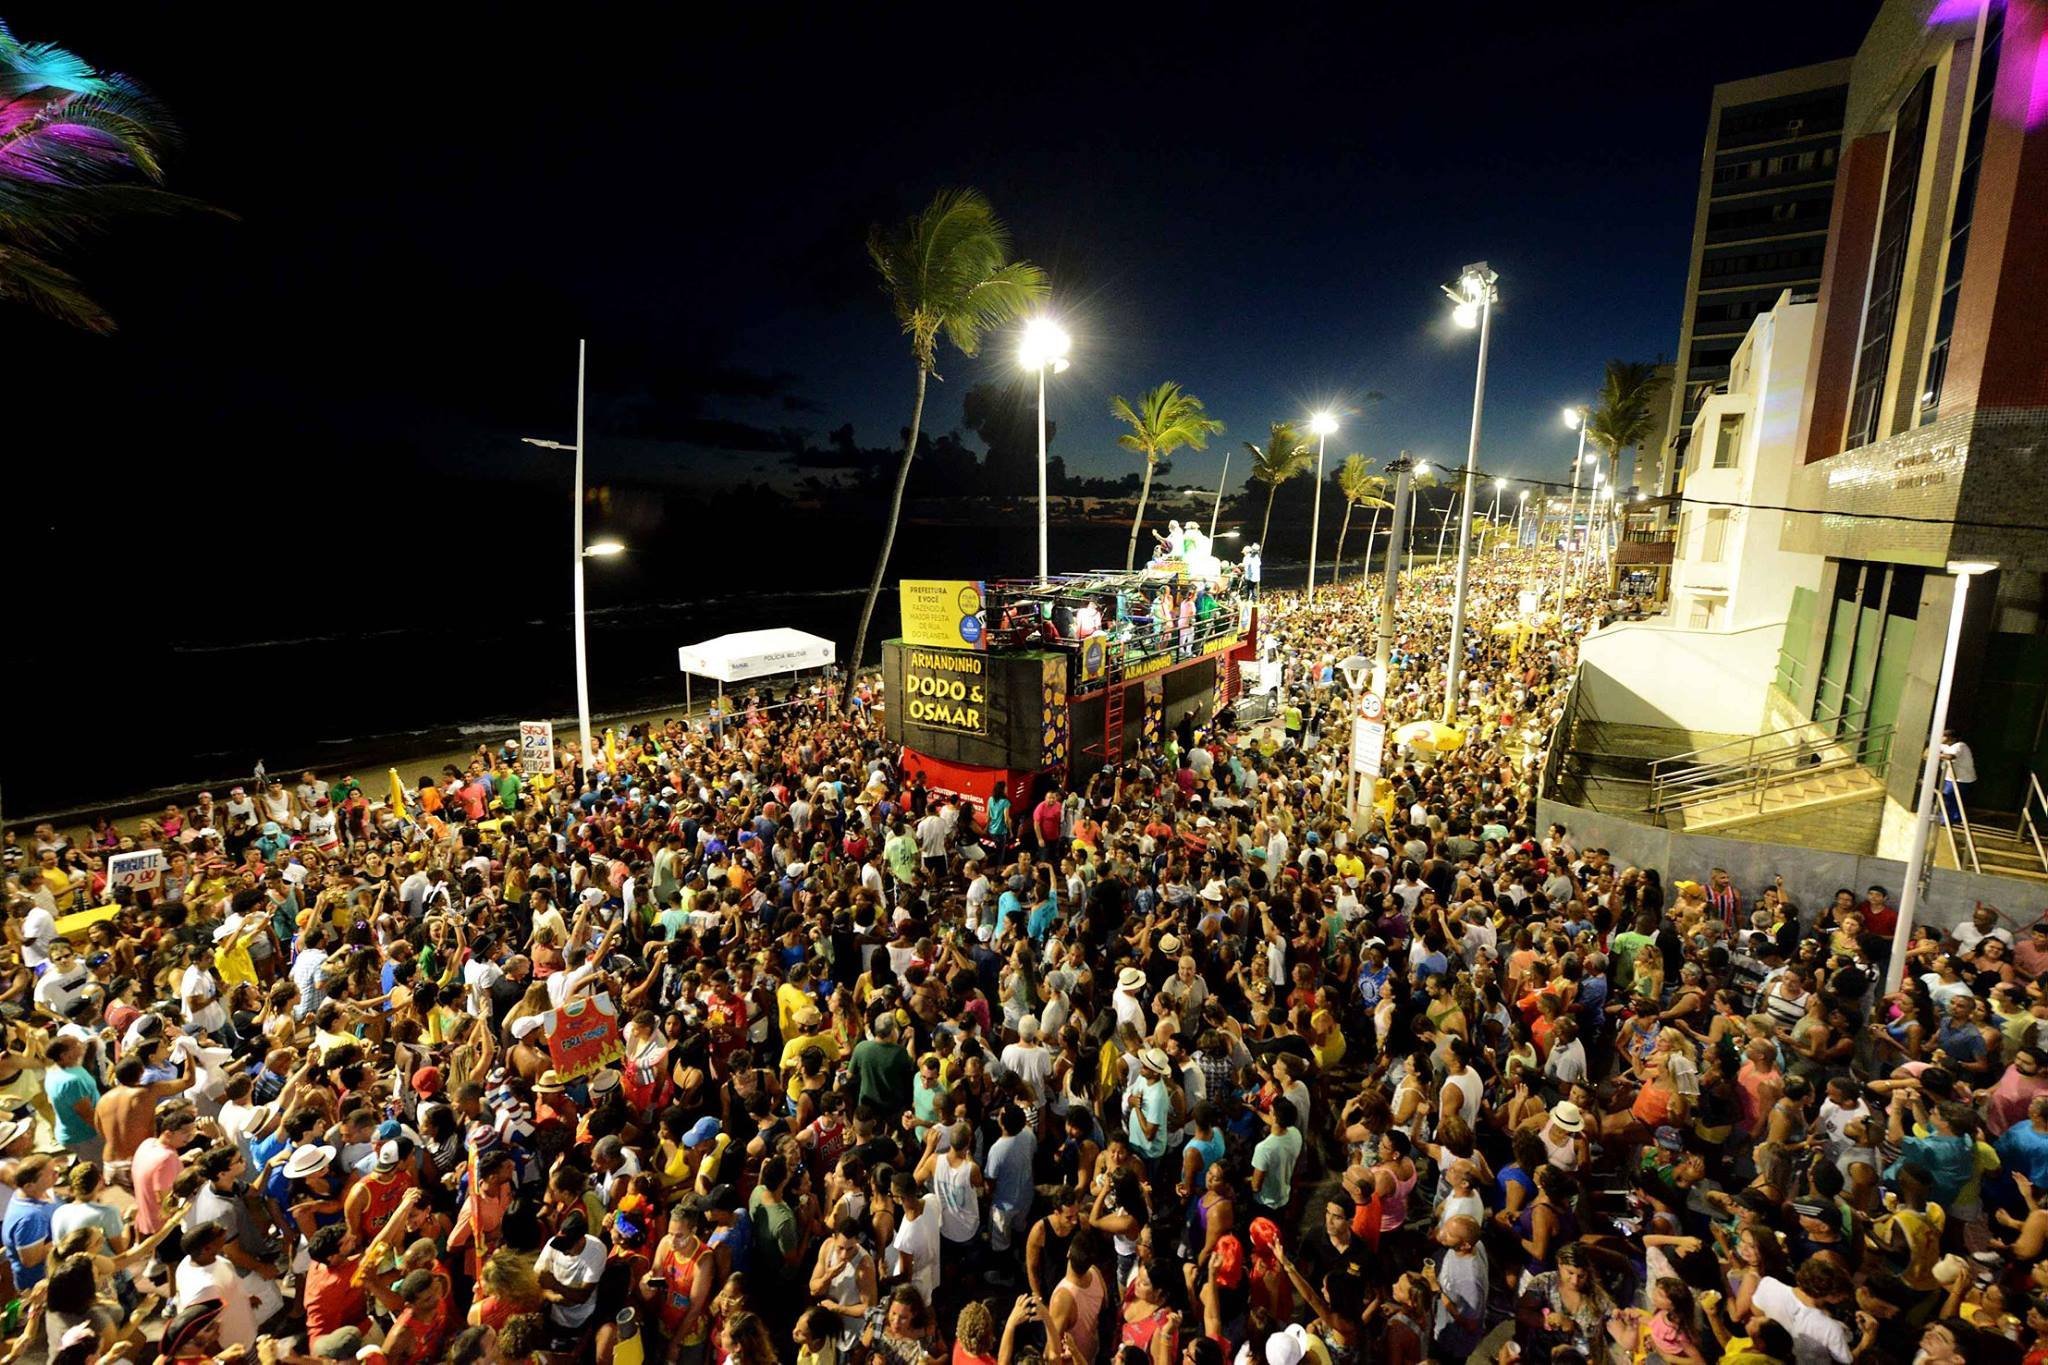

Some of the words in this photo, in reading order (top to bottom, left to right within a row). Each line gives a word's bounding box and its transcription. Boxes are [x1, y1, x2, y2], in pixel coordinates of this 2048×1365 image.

[910, 586, 947, 594] PREFEITURA
[911, 653, 982, 674] ARMANDINHO
[970, 685, 983, 703] &
[909, 700, 980, 729] OSMAR
[522, 725, 548, 736] SKOL
